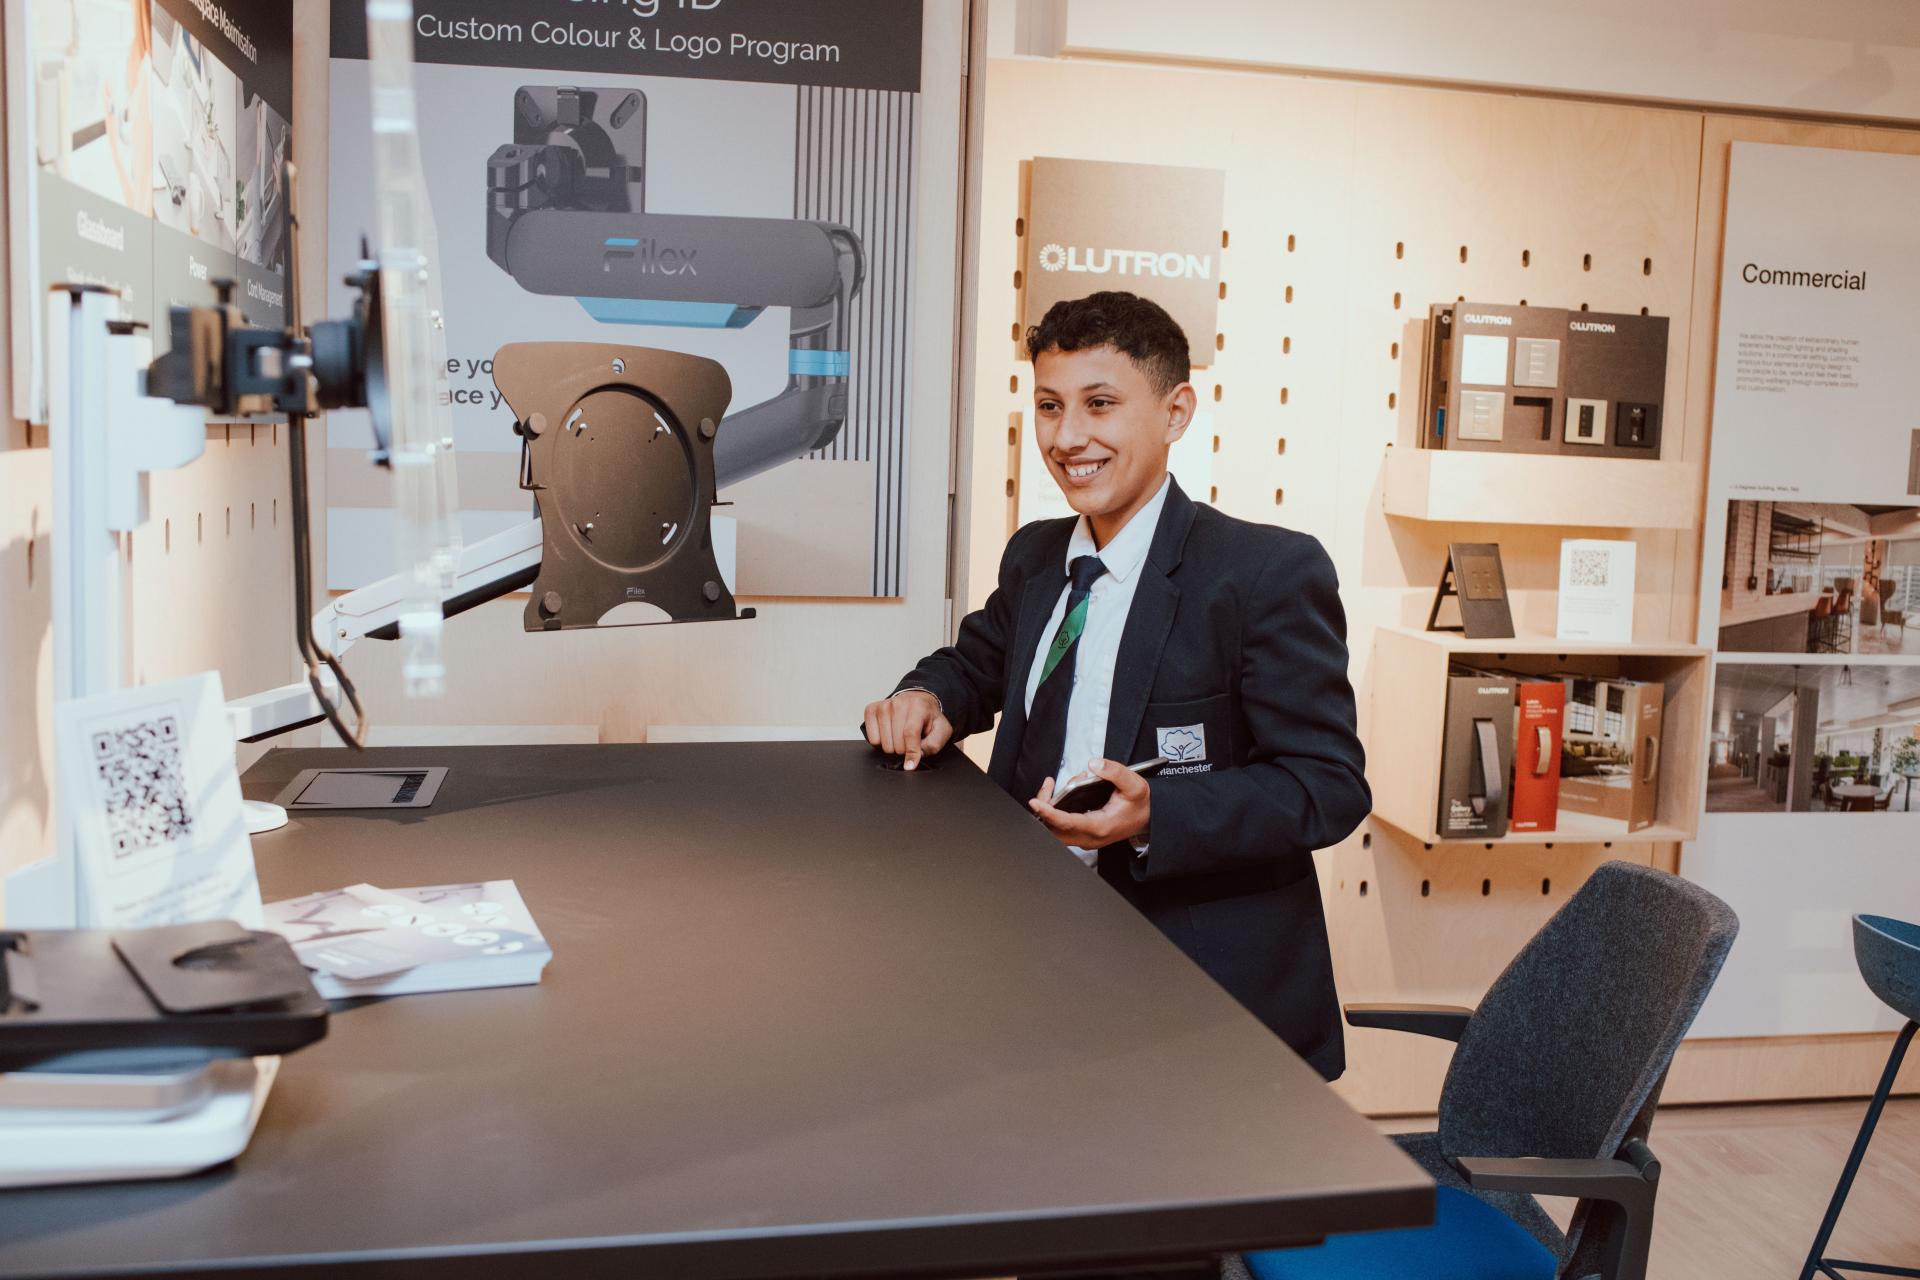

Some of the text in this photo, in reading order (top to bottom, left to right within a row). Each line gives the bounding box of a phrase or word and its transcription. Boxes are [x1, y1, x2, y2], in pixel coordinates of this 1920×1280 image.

[219, 5, 257, 65] Maximisation
[416, 14, 840, 64] Custom Colour & Logo Program
[189, 256, 207, 281] Power
[603, 237, 697, 277] Filex
[1066, 246, 1211, 280] LUTRON
[247, 278, 284, 308] Cord Management
[1742, 262, 1866, 291] Commercial
